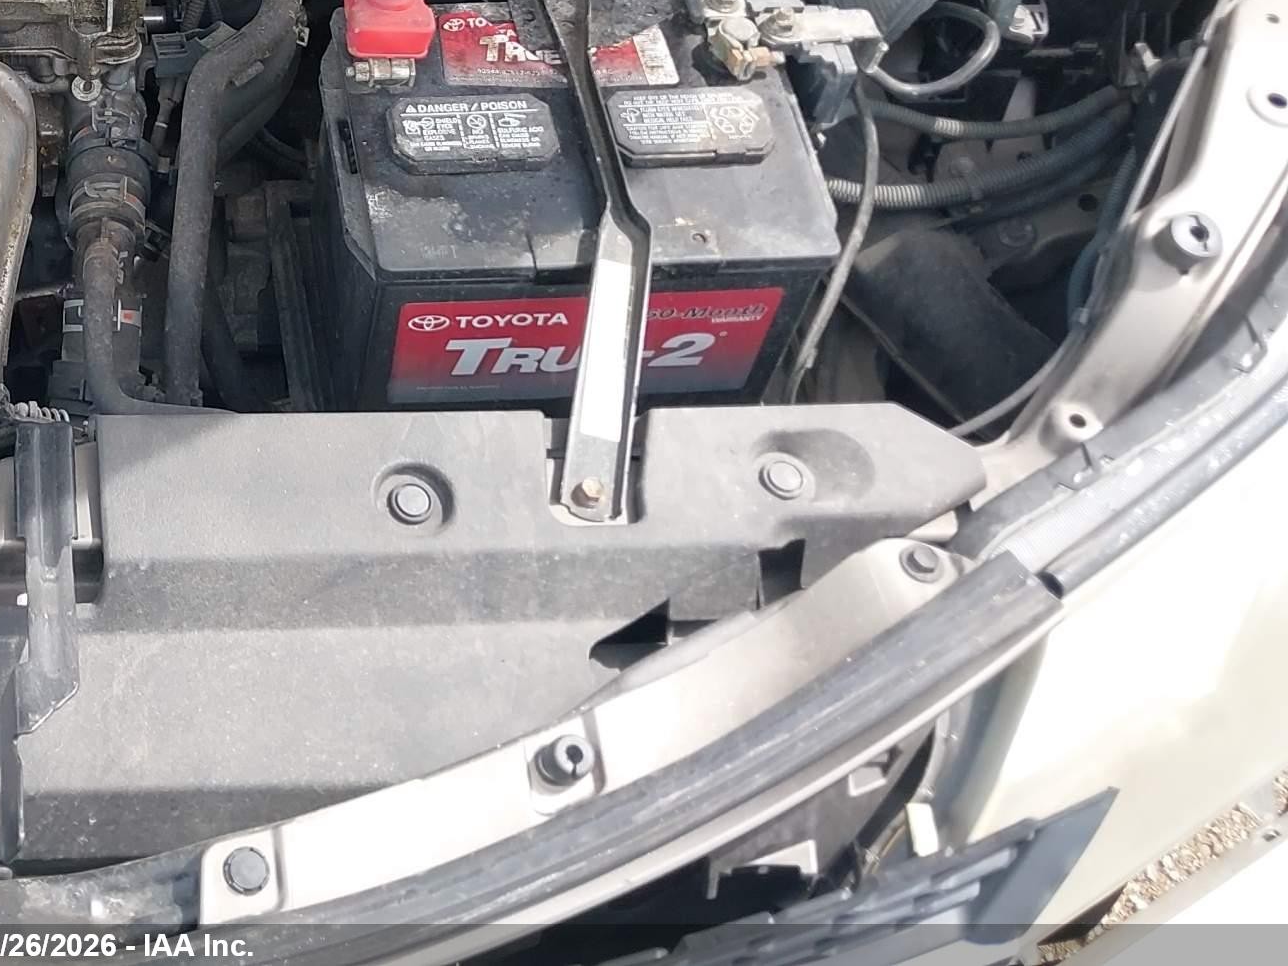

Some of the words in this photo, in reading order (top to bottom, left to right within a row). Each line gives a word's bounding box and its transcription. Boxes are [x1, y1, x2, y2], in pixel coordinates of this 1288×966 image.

[417, 103, 469, 114] DANGER
[480, 100, 528, 111] POISON
[455, 312, 569, 329] TOYOTA
